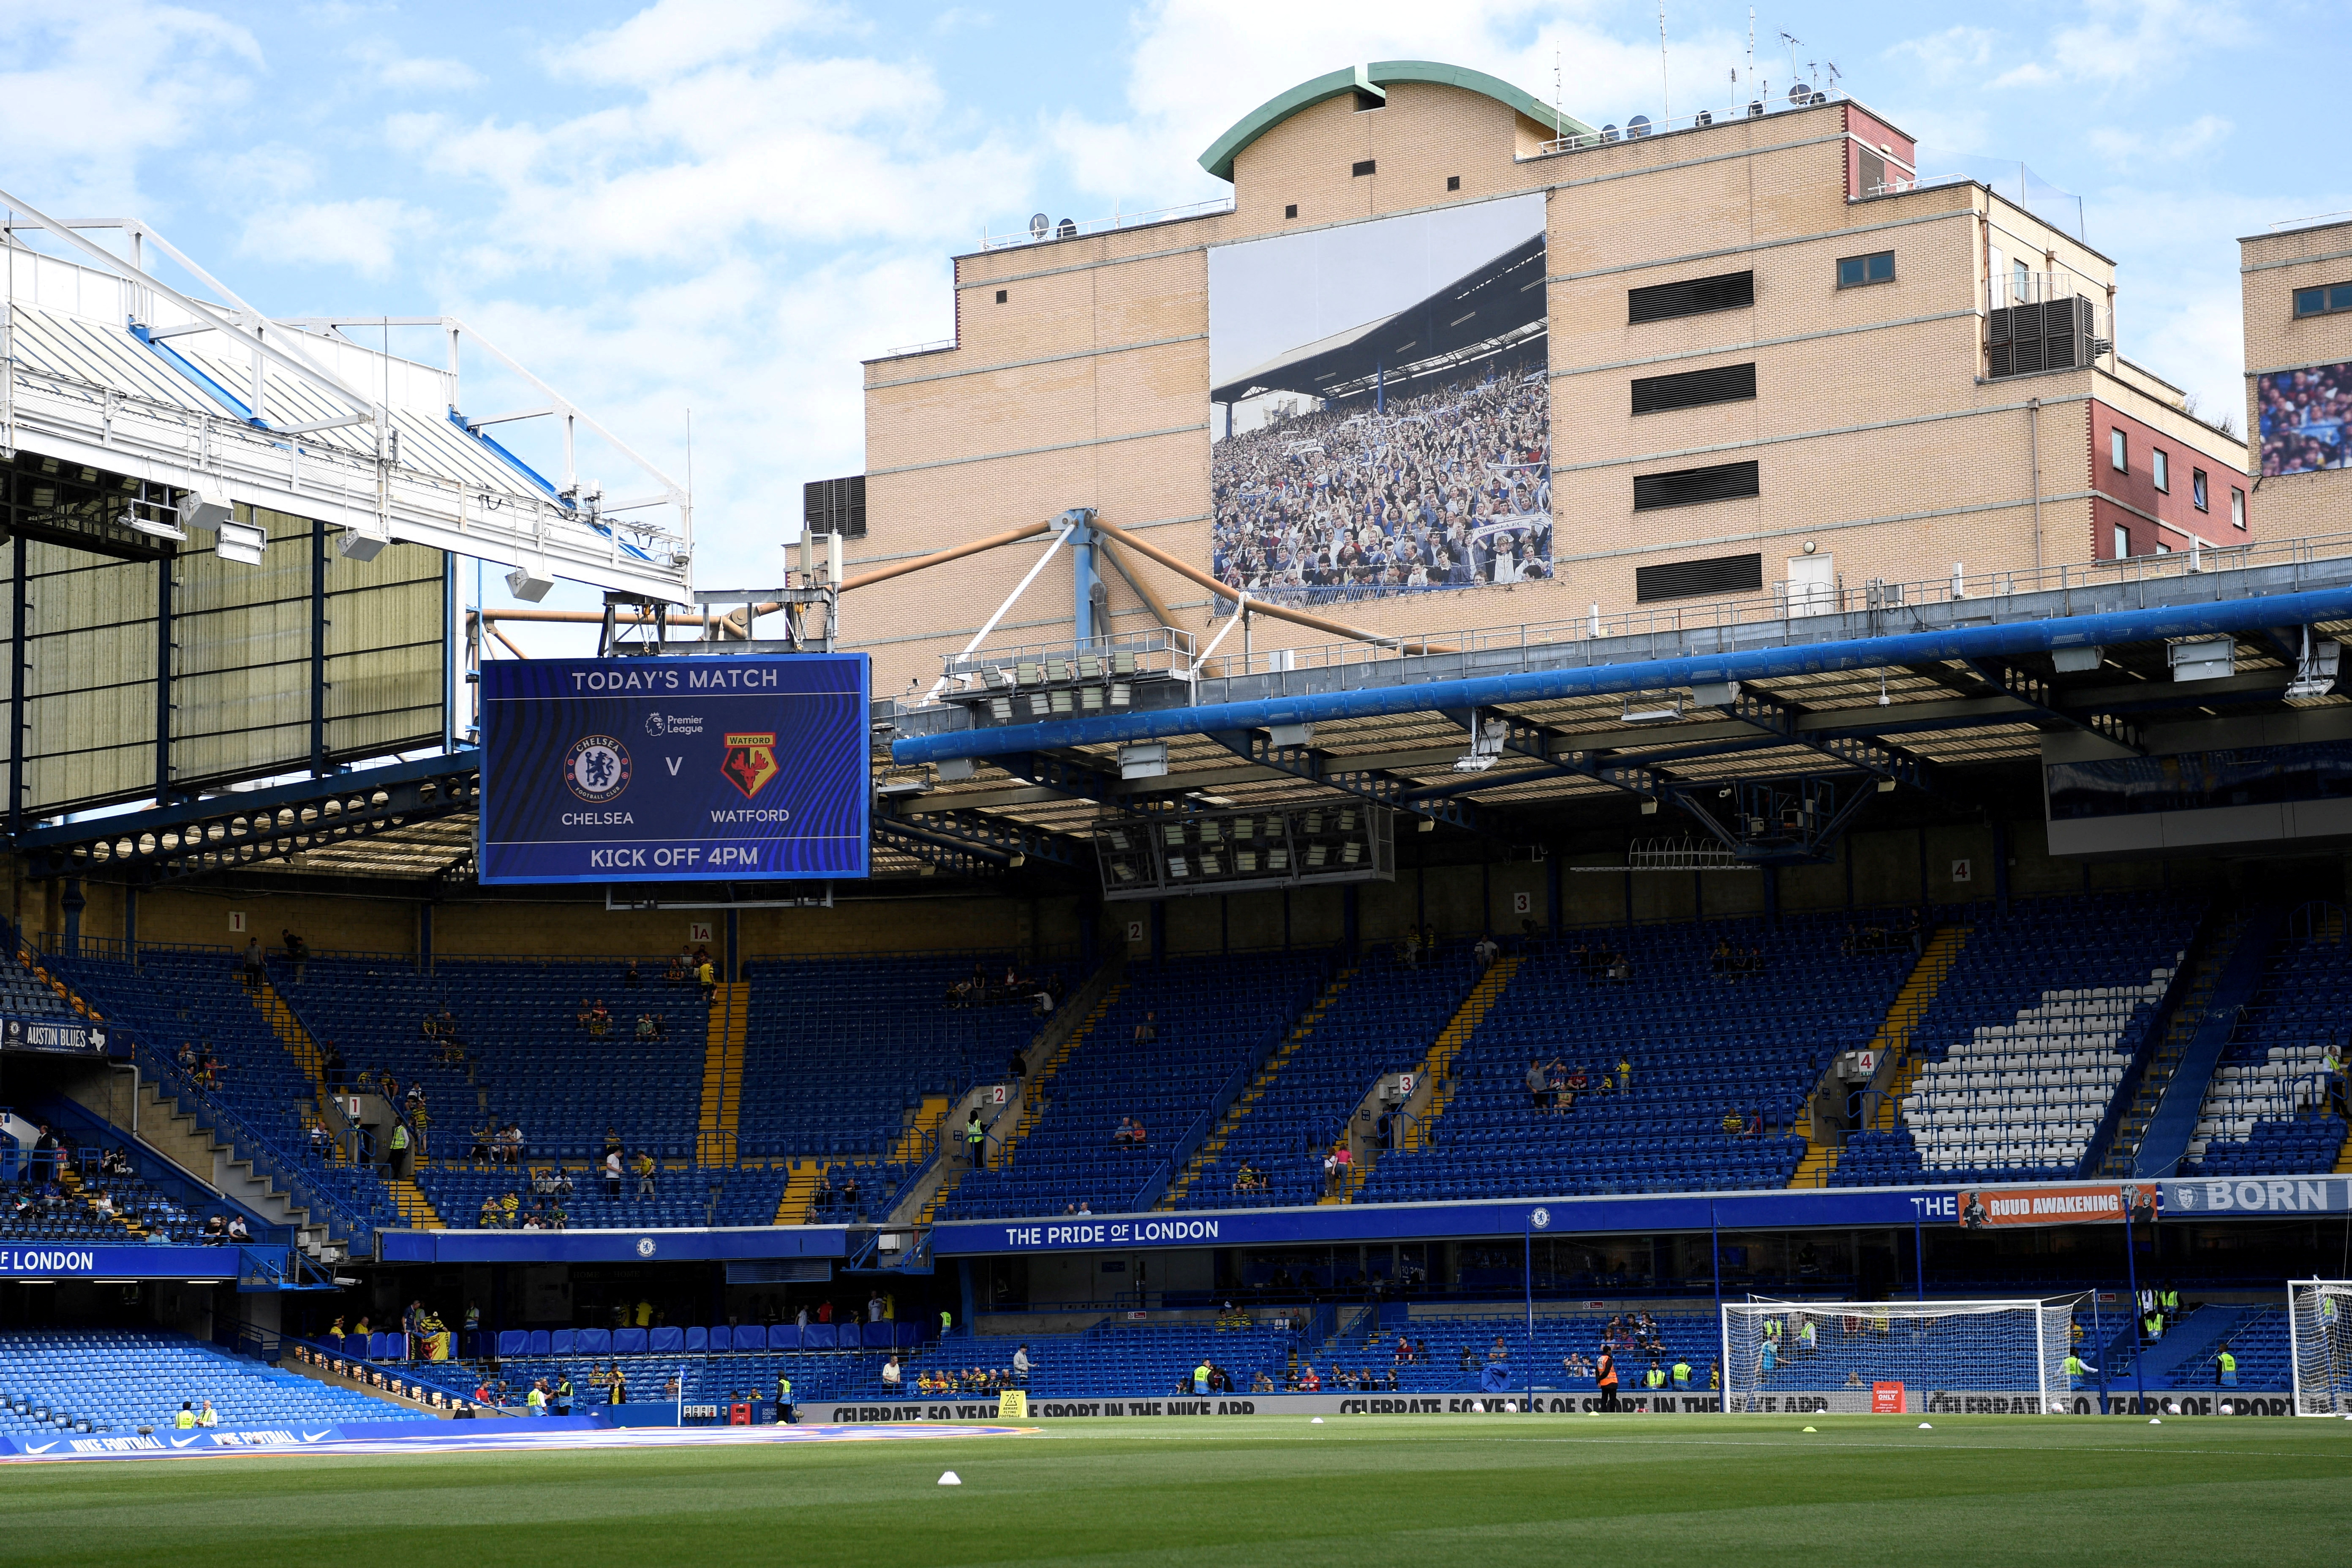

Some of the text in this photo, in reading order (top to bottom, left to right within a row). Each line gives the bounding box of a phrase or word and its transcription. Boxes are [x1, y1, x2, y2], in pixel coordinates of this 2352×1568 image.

[572, 669, 777, 690] TODAY'S MATCH
[667, 715, 703, 724] Premier
[667, 724, 703, 735] League
[576, 738, 619, 753] CHELSEA
[730, 737, 770, 745] WATFORD
[575, 787, 621, 799] FOOTBALL CLUB
[561, 812, 634, 826] CHELSEA
[711, 810, 789, 823] WATFORD
[592, 847, 758, 868] KICK OFF 4PM
[1955, 863, 1968, 878] 4
[1517, 895, 1527, 911] 3
[234, 914, 240, 929] 1
[693, 925, 709, 939] 1A
[1131, 923, 1140, 938] 2
[27, 1026, 86, 1048] AUSTIN BLUES
[1860, 1054, 1872, 1069] 4
[1402, 1077, 1411, 1091] 3
[995, 1088, 1003, 1102] 2
[353, 1098, 357, 1113] 1
[2207, 1181, 2328, 1211] BORN
[1910, 1197, 1956, 1216] THE
[1990, 1194, 2118, 1216] RUUD AWAKENING
[1006, 1221, 1218, 1245] THE PRIDE OF LONDON
[0, 1251, 93, 1270] F LONDON
[833, 1406, 921, 1423] CELEBRATE
[929, 1406, 951, 1420] 50
[956, 1405, 1000, 1419] YEAR
[1044, 1403, 1100, 1417] SPORT
[1105, 1403, 1123, 1416] IN
[1129, 1402, 1161, 1416] THE
[1168, 1402, 1211, 1416] NIKE
[1218, 1401, 1255, 1415] APP
[1340, 1399, 1441, 1413] CELEBRATE
[1550, 1398, 1576, 1413] OF
[1653, 1397, 1676, 1413] IN
[1682, 1397, 1720, 1413] THE
[1929, 1396, 2041, 1414] CELEBRAT
[2181, 1397, 2210, 1415] OF
[70, 1436, 166, 1452] NIKE FOOTBALL
